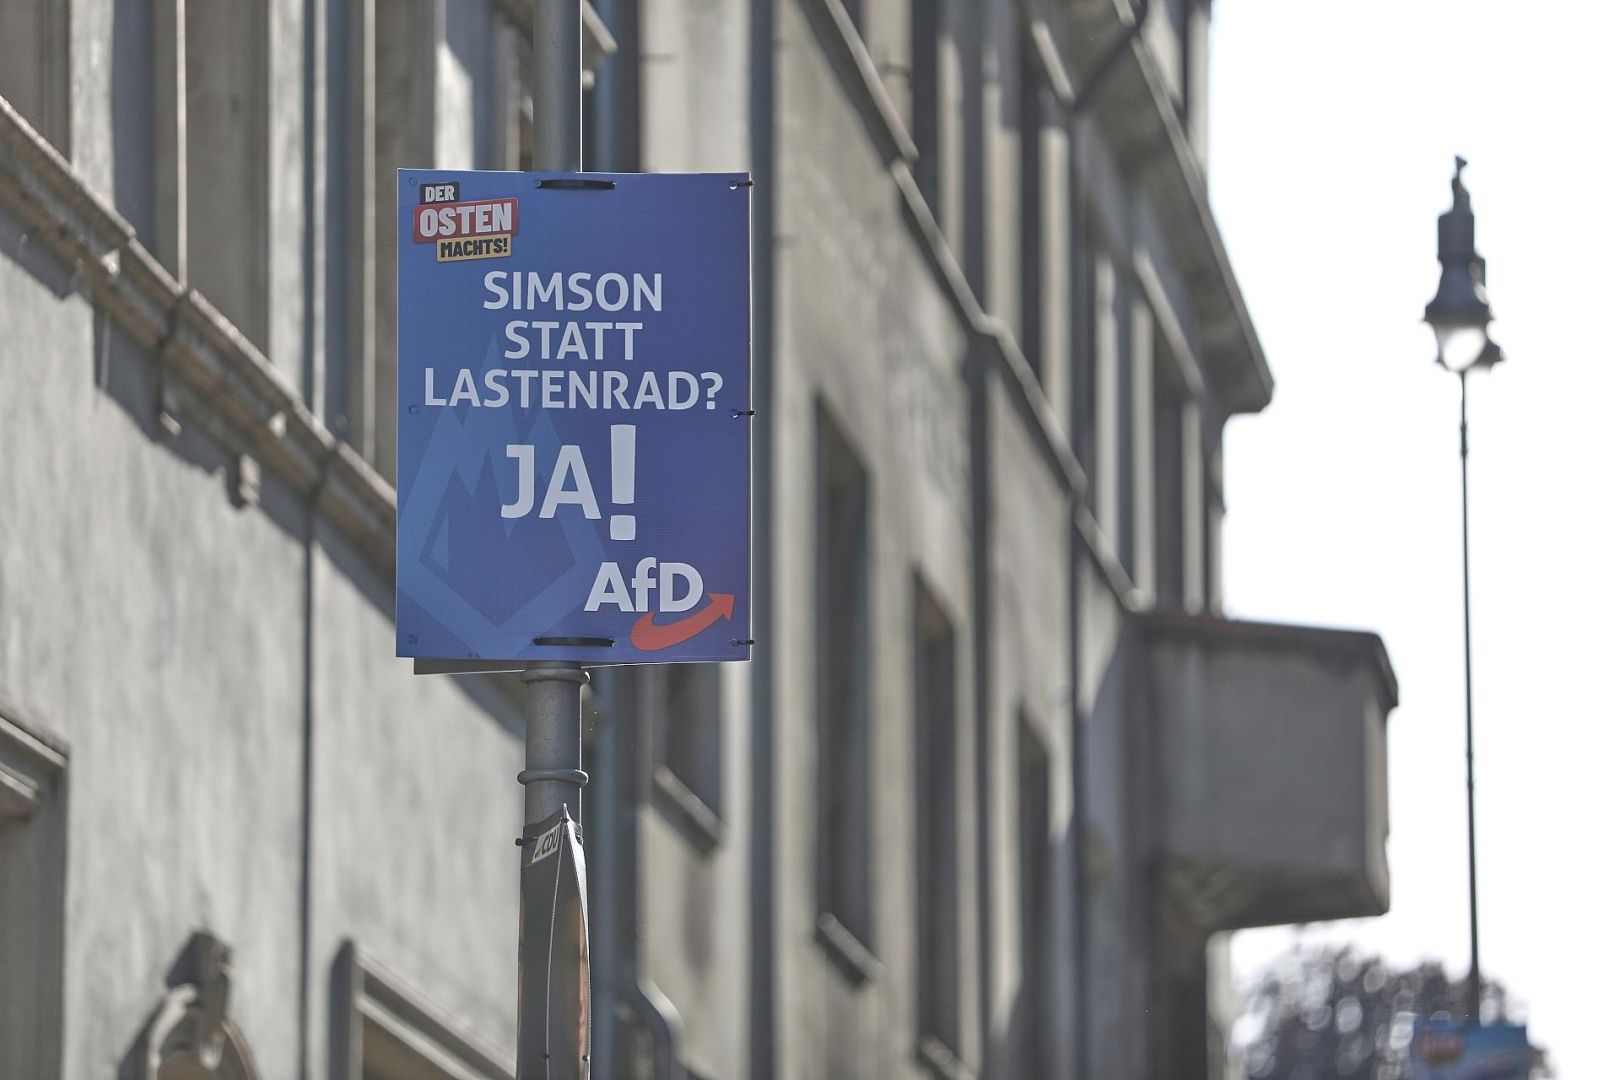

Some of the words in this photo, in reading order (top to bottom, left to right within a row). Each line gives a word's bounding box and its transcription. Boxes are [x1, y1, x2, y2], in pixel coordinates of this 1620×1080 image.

[425, 185, 455, 203] DER
[420, 202, 512, 237] OSTEN
[440, 238, 508, 258] MACHTS!
[483, 271, 662, 312] SIMSON
[504, 320, 643, 360] STATT
[425, 368, 724, 410] LASTENRAD?
[501, 424, 637, 541] JA!
[584, 557, 704, 613] AfD
[541, 828, 560, 855] CDU
